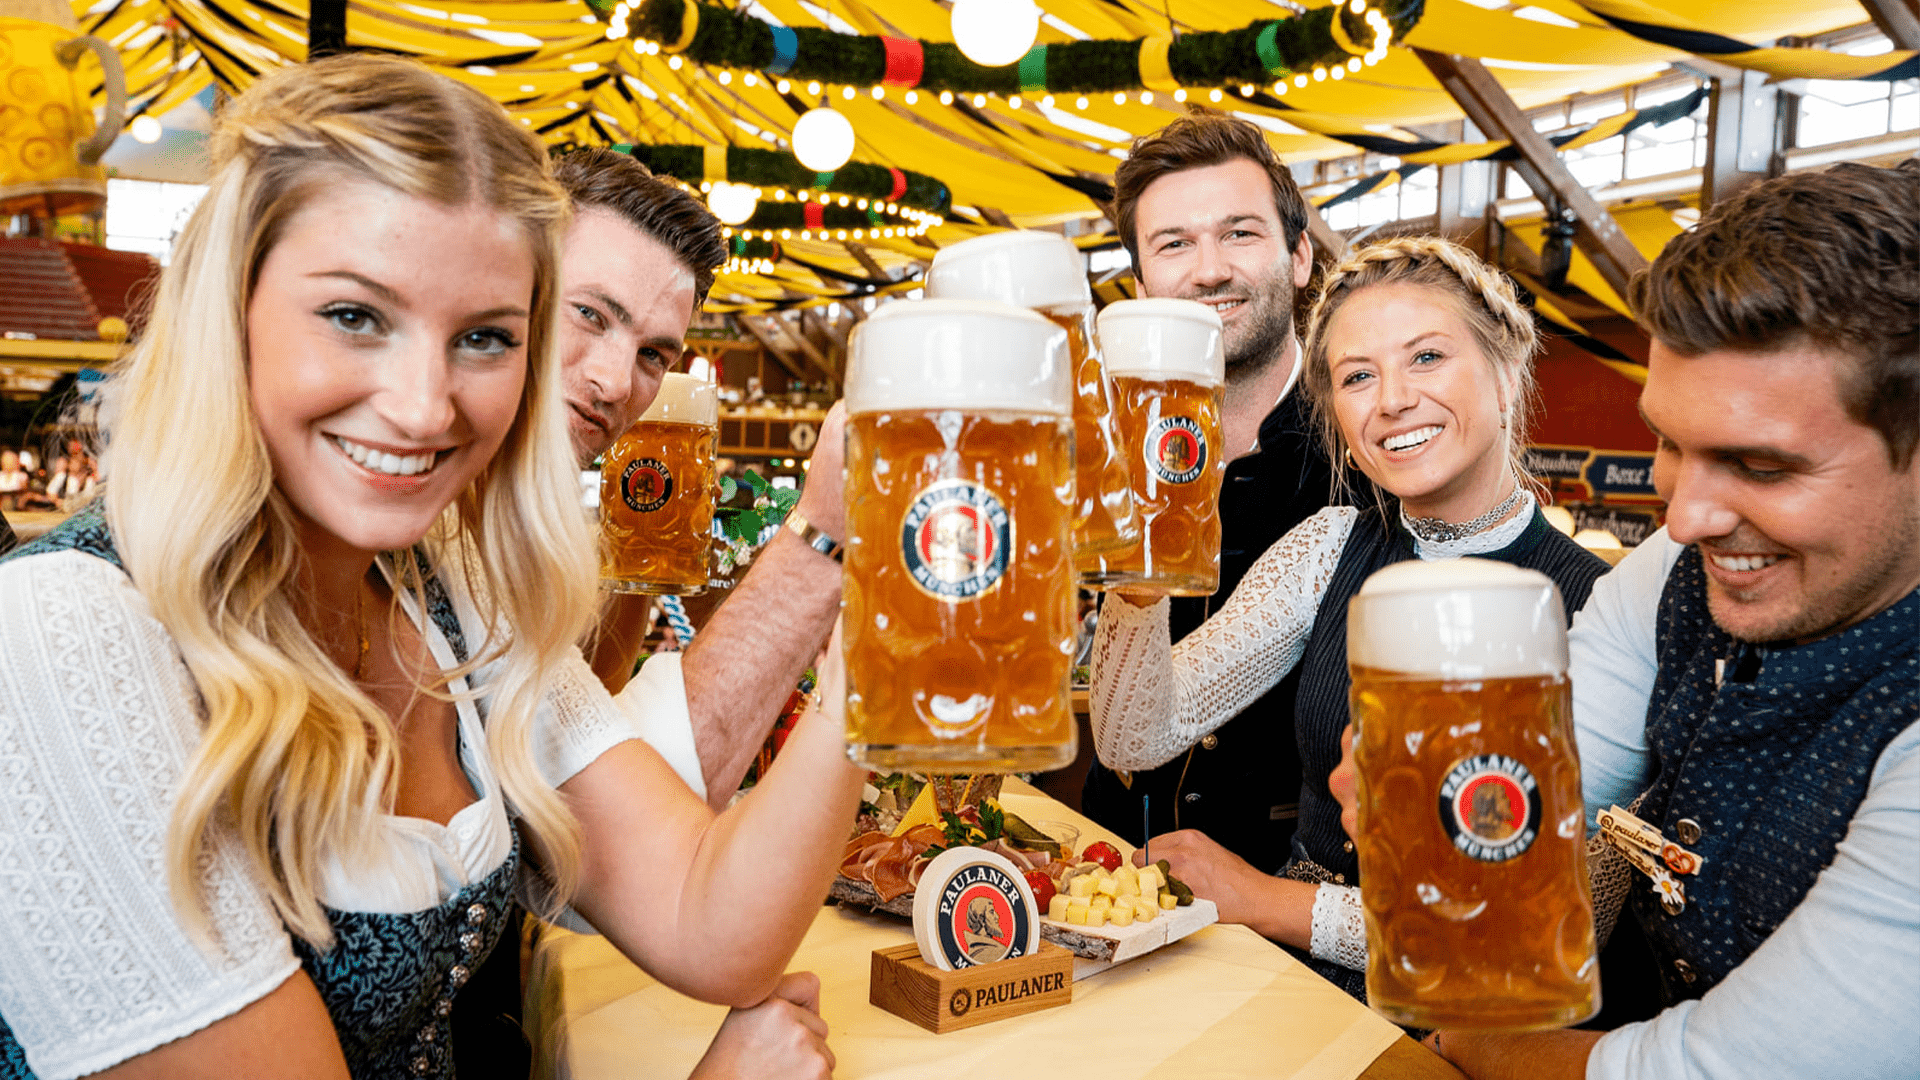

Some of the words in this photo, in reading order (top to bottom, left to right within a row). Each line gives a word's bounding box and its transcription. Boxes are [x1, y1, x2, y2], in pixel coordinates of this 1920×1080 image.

[623, 460, 671, 480] PAULANER
[905, 487, 1007, 528] PAULANER
[1441, 753, 1536, 799] PAULANER
[940, 867, 1020, 916] PAULANER
[975, 971, 1065, 1008] PAULANER
